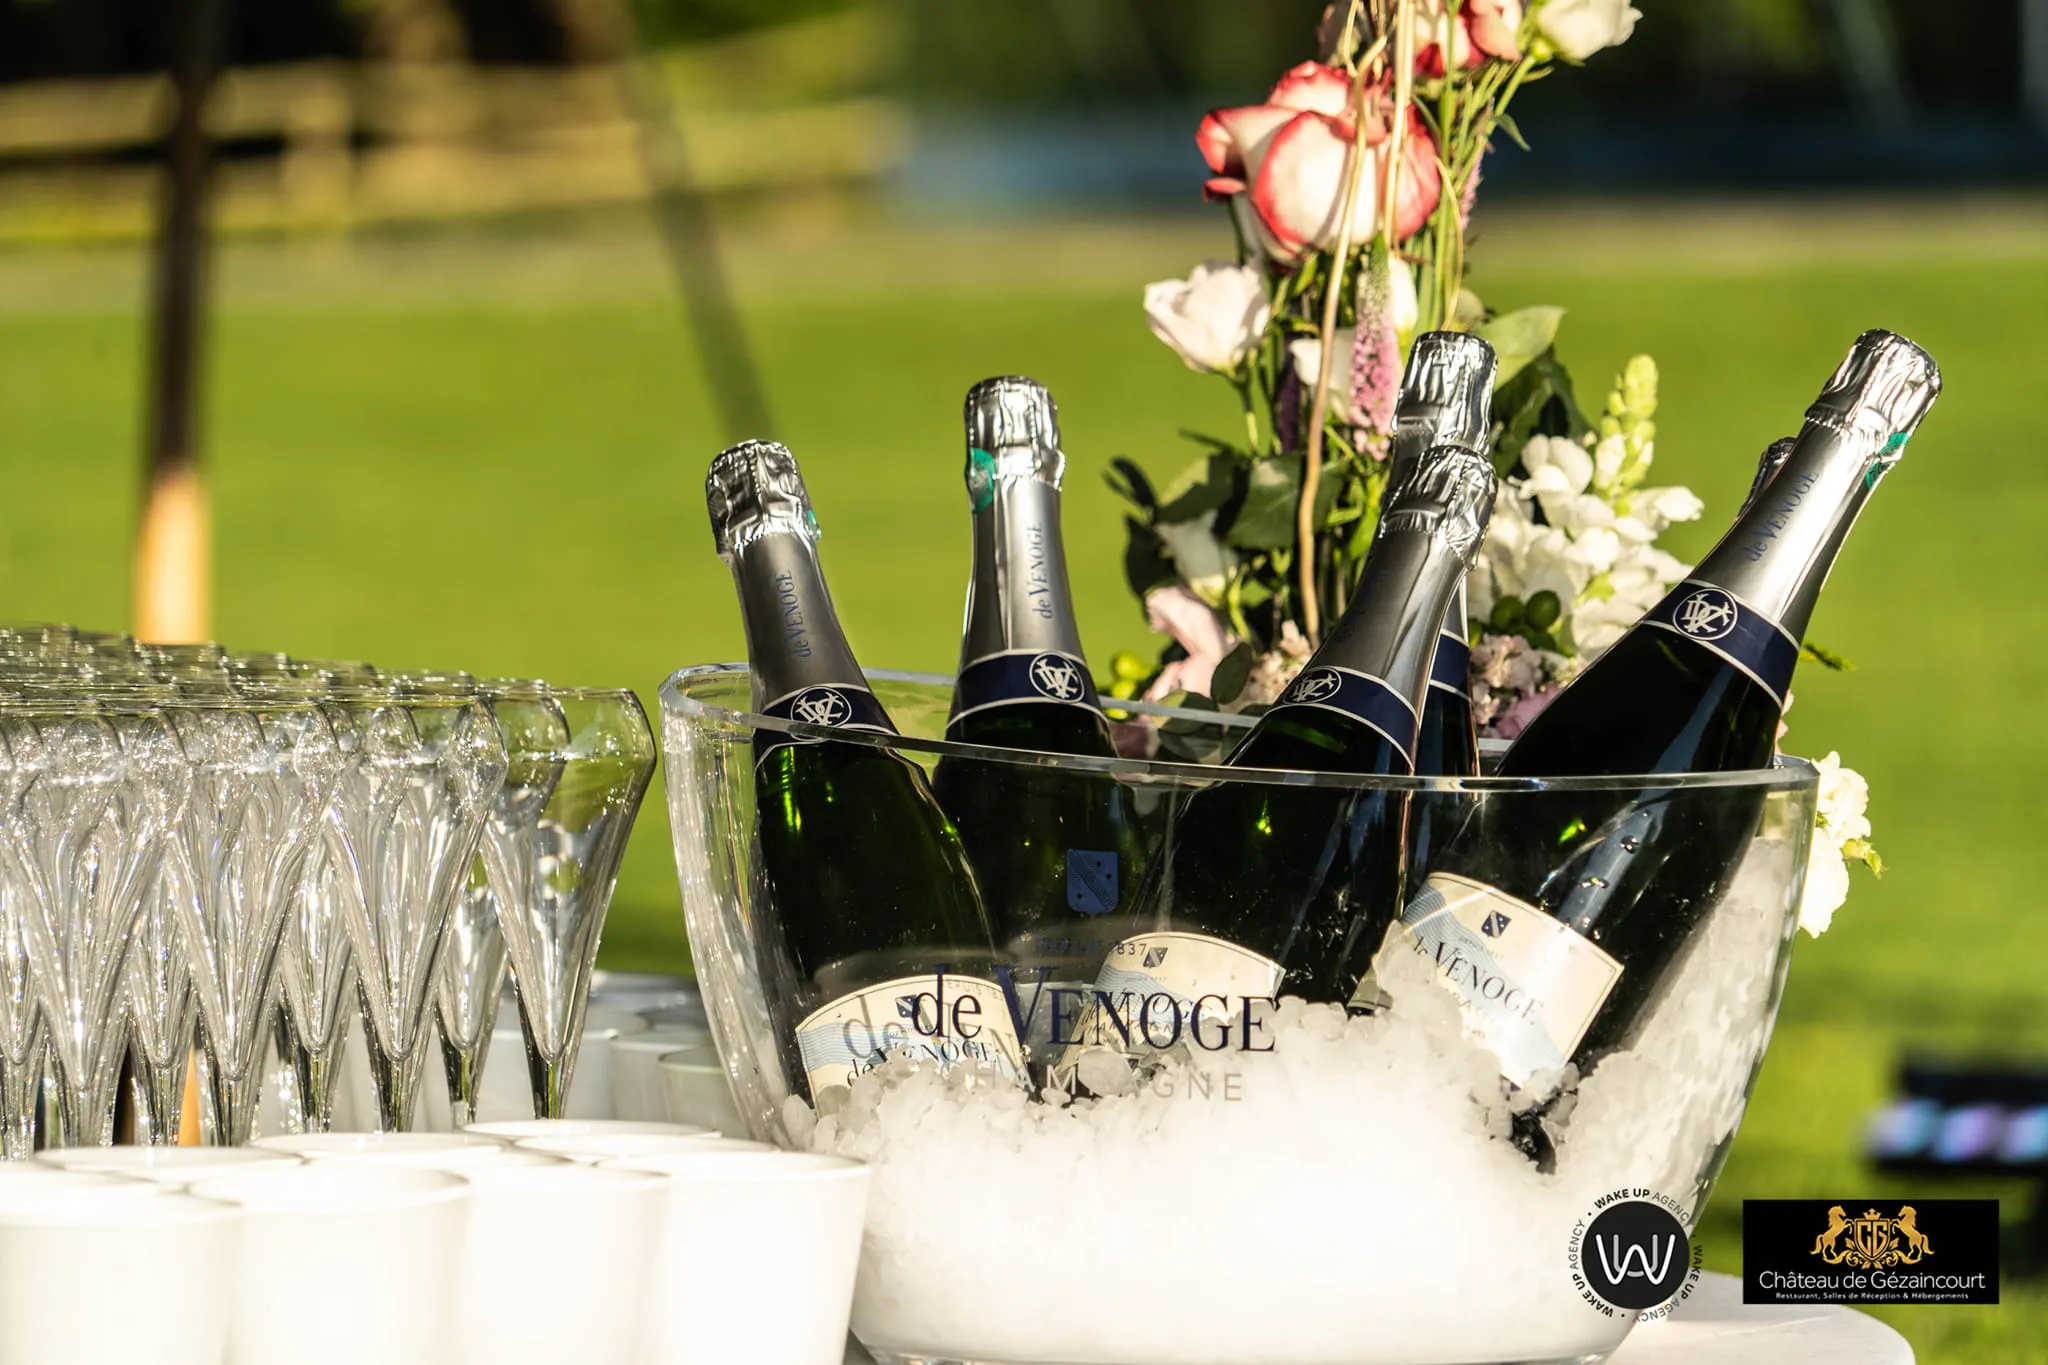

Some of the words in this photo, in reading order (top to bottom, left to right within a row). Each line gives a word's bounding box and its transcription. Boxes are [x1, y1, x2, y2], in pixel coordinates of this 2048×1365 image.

[1744, 541, 1767, 562] de
[1756, 473, 1819, 540] VENOGE
[1026, 522, 1051, 597] VENOGE
[776, 570, 807, 644] VENOGE
[1032, 599, 1053, 620] de
[789, 640, 811, 658] de
[912, 964, 982, 1039] de
[993, 964, 1276, 1052] VENOGE
